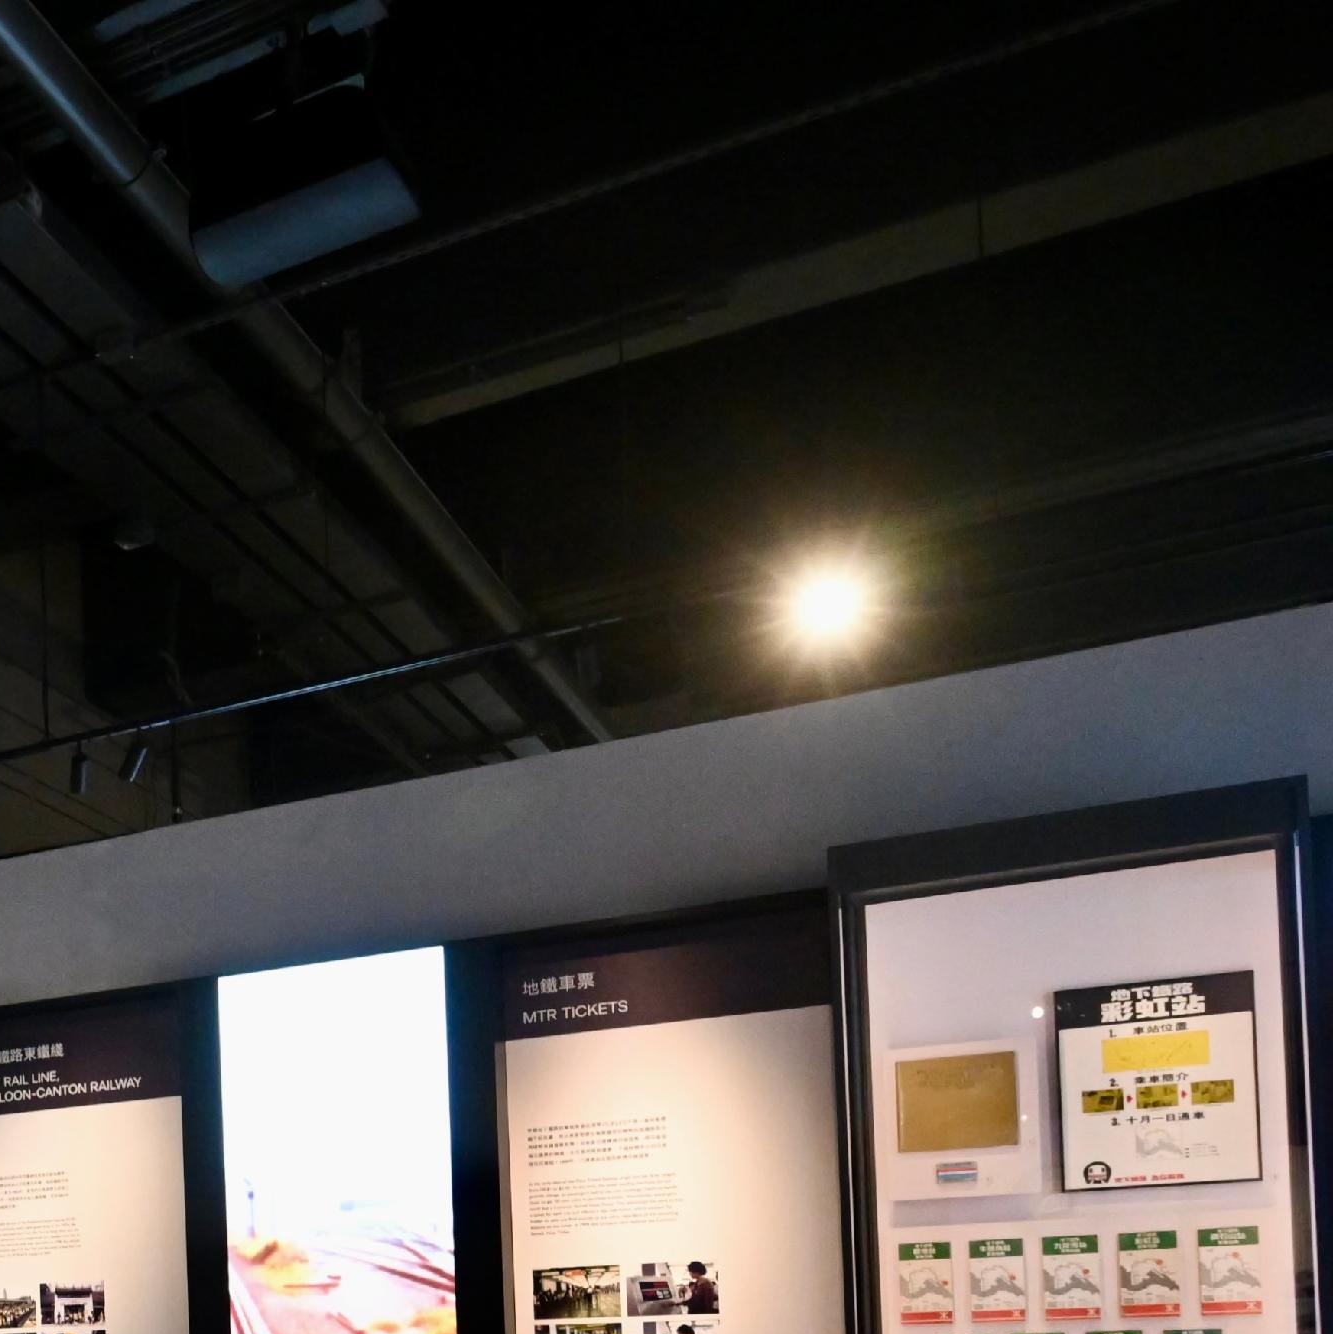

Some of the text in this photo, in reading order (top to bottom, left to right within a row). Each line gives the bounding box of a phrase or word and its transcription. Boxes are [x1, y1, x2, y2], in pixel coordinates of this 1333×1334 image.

[522, 972, 595, 996] 地鐵車票
[522, 1000, 628, 1024] MTR TICKETS
[1100, 994, 1206, 1024] 彩虹站
[3, 1074, 29, 1088] RAIL
[31, 1070, 60, 1084] LINE,
[90, 1077, 142, 1092] RAILWAY
